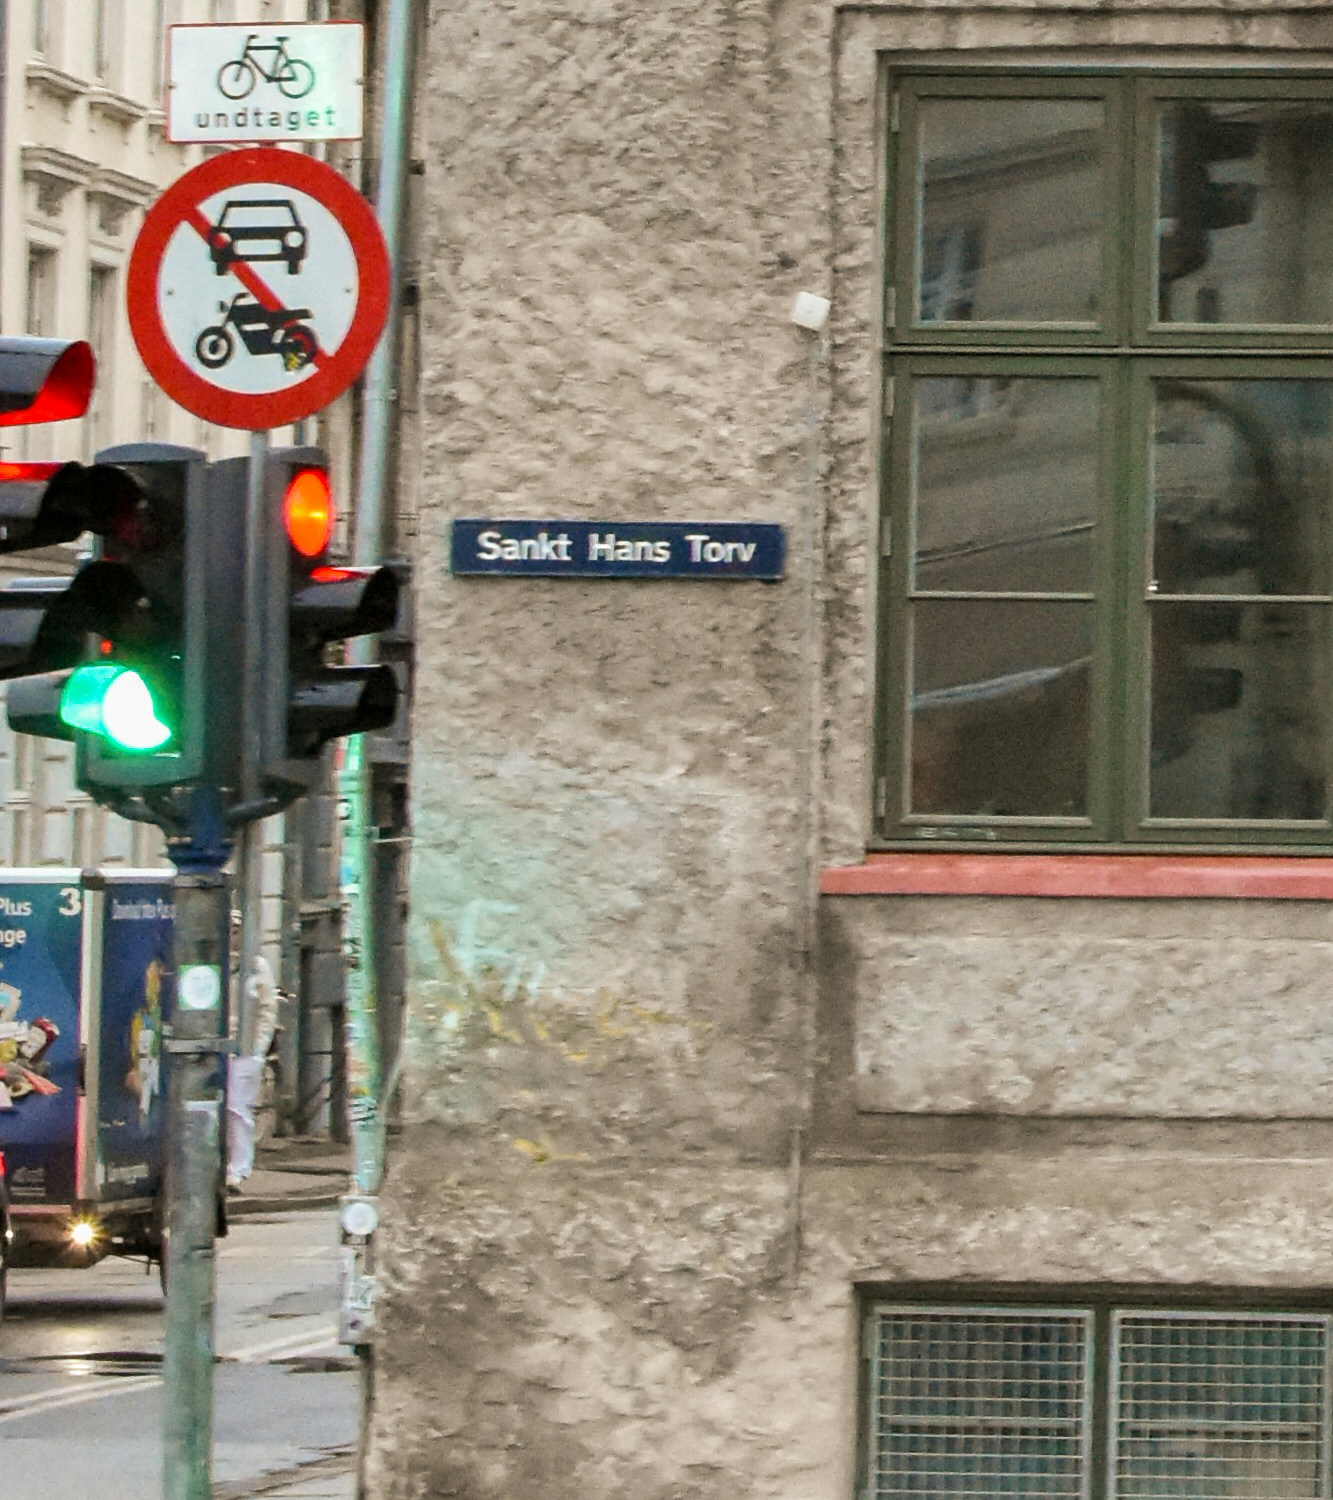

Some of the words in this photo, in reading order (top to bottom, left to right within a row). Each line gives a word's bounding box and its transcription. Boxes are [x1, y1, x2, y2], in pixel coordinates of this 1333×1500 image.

[195, 106, 335, 131] undtaget
[476, 531, 573, 561] Sankt
[588, 533, 671, 563] Hans
[684, 534, 757, 563] Torv
[59, 887, 81, 916] 3
